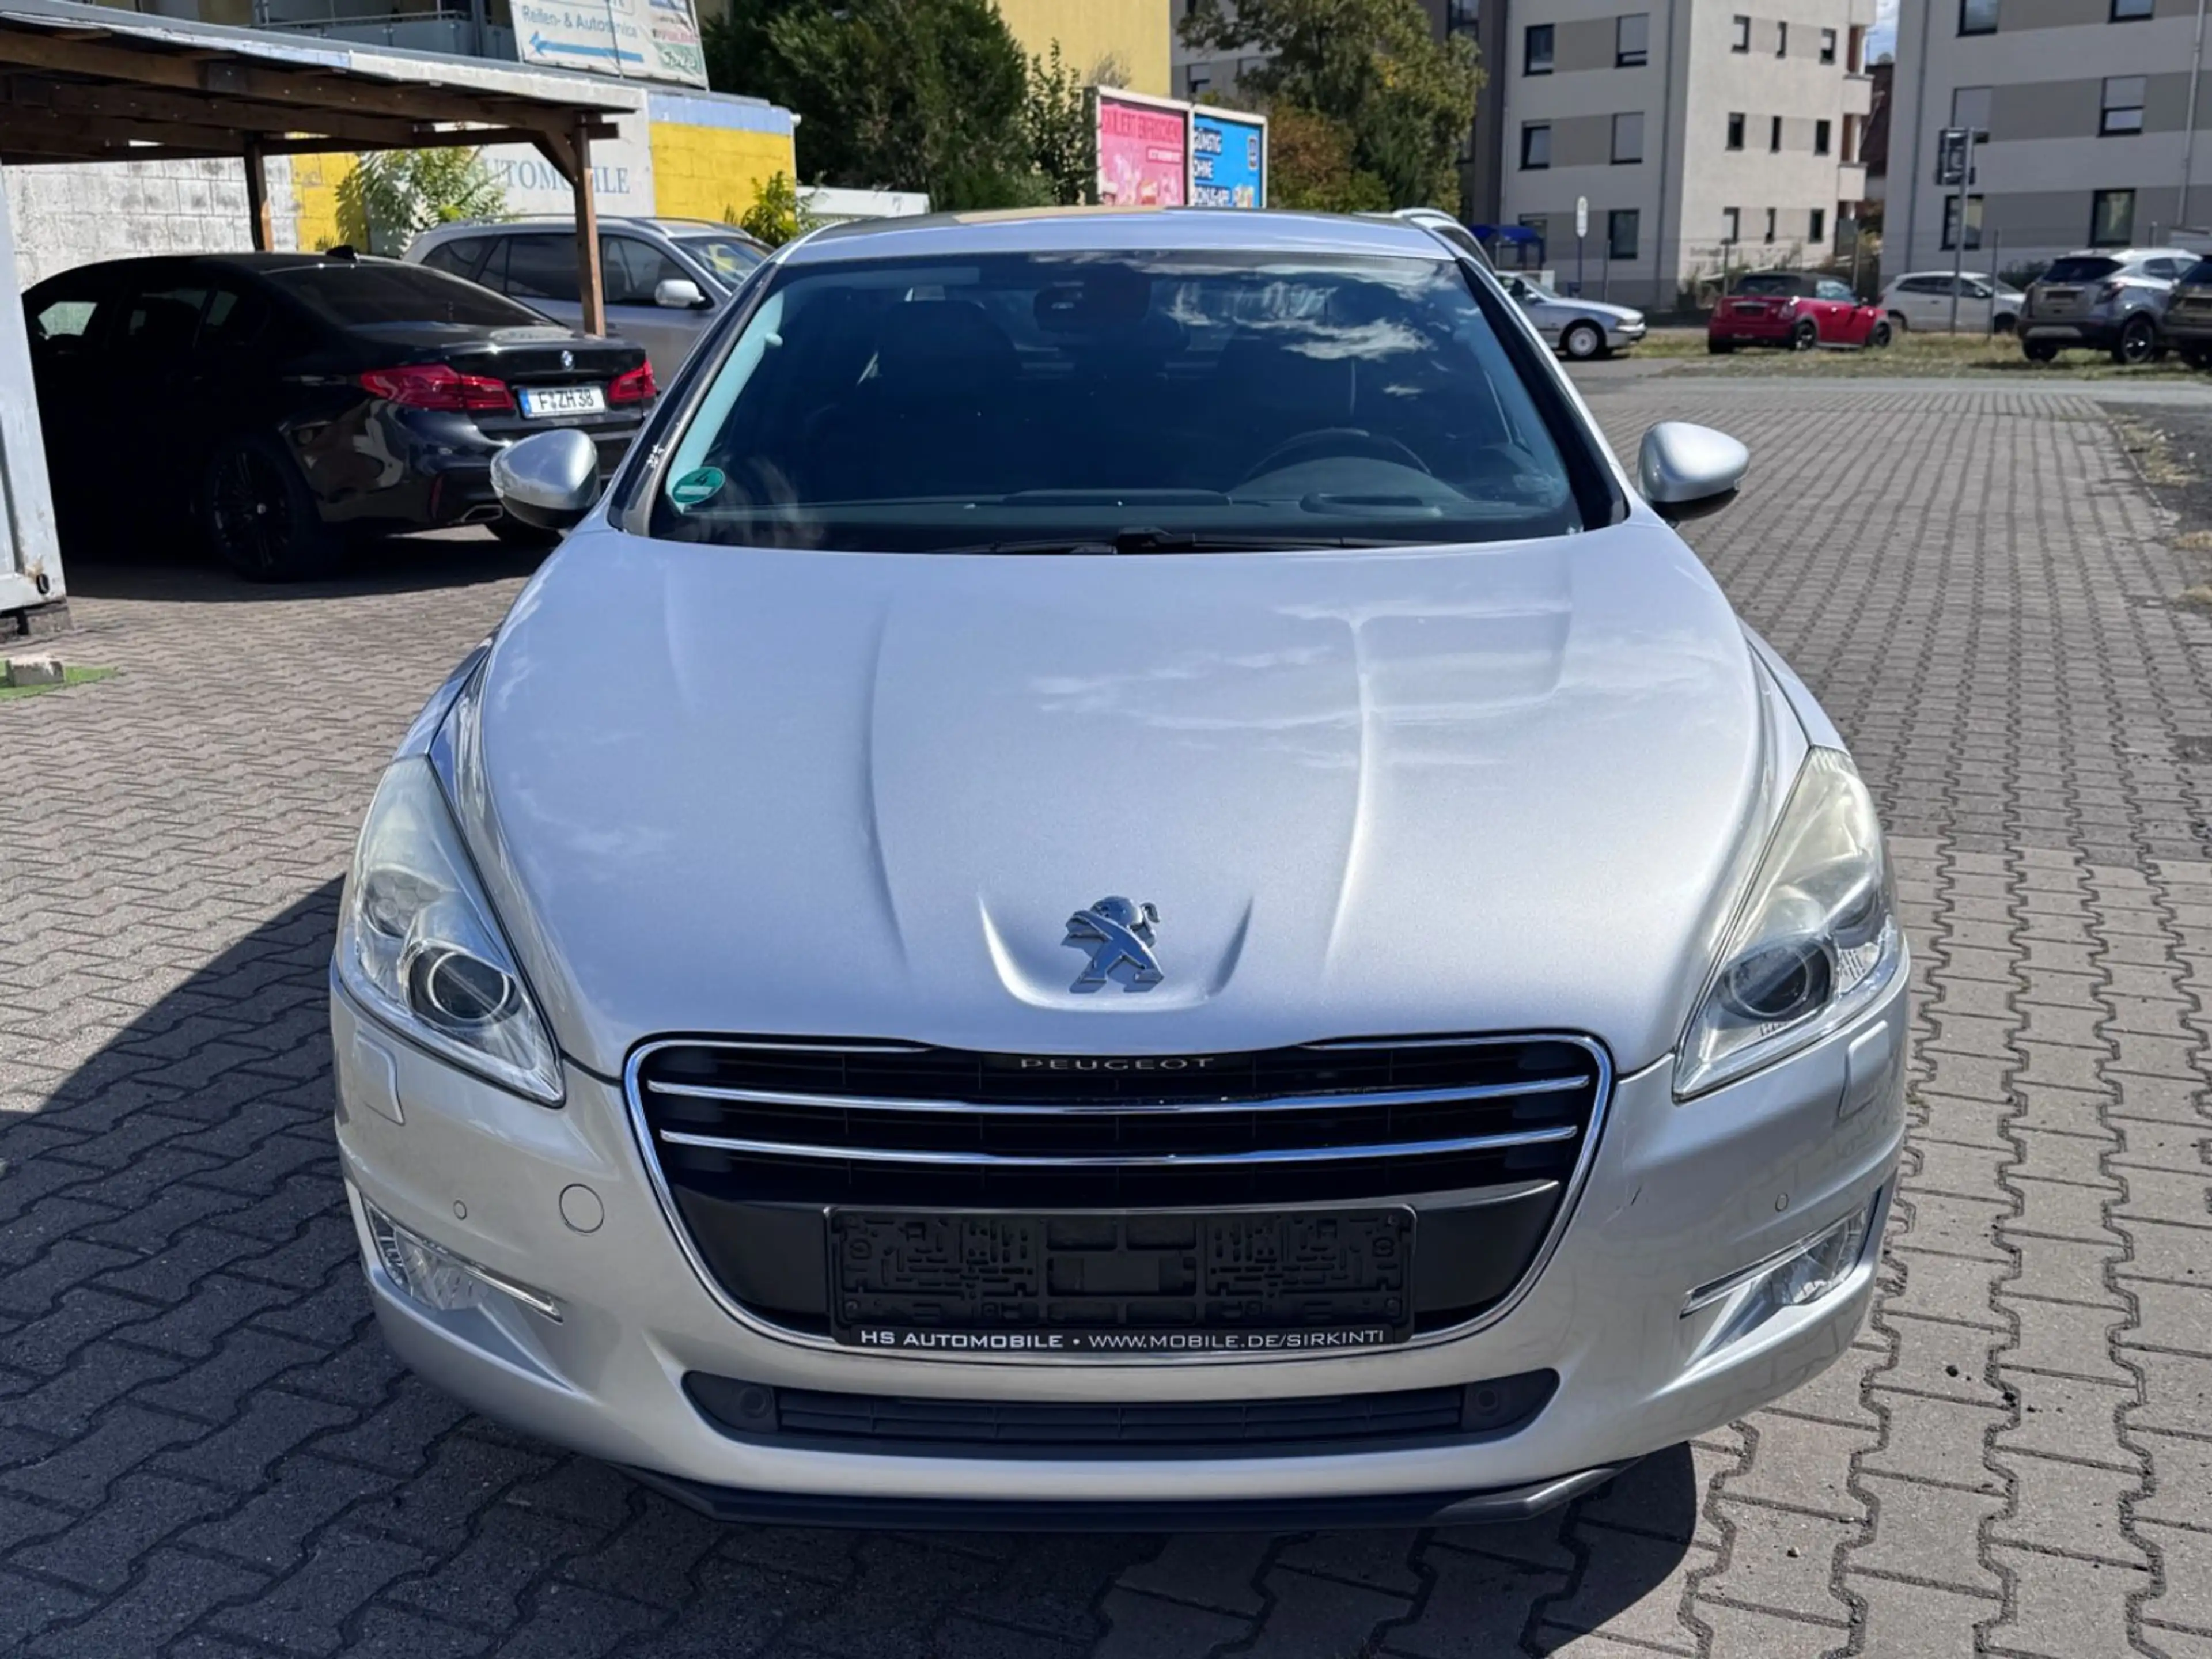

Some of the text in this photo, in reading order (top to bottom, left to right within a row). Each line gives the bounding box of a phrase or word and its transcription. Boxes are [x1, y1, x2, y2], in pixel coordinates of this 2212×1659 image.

[1021, 1057, 1214, 1071] PEUGEOT
[861, 1330, 1384, 1349] HS AUTOMOBILE WWW.MOBILE.DE/SIRKINTI
